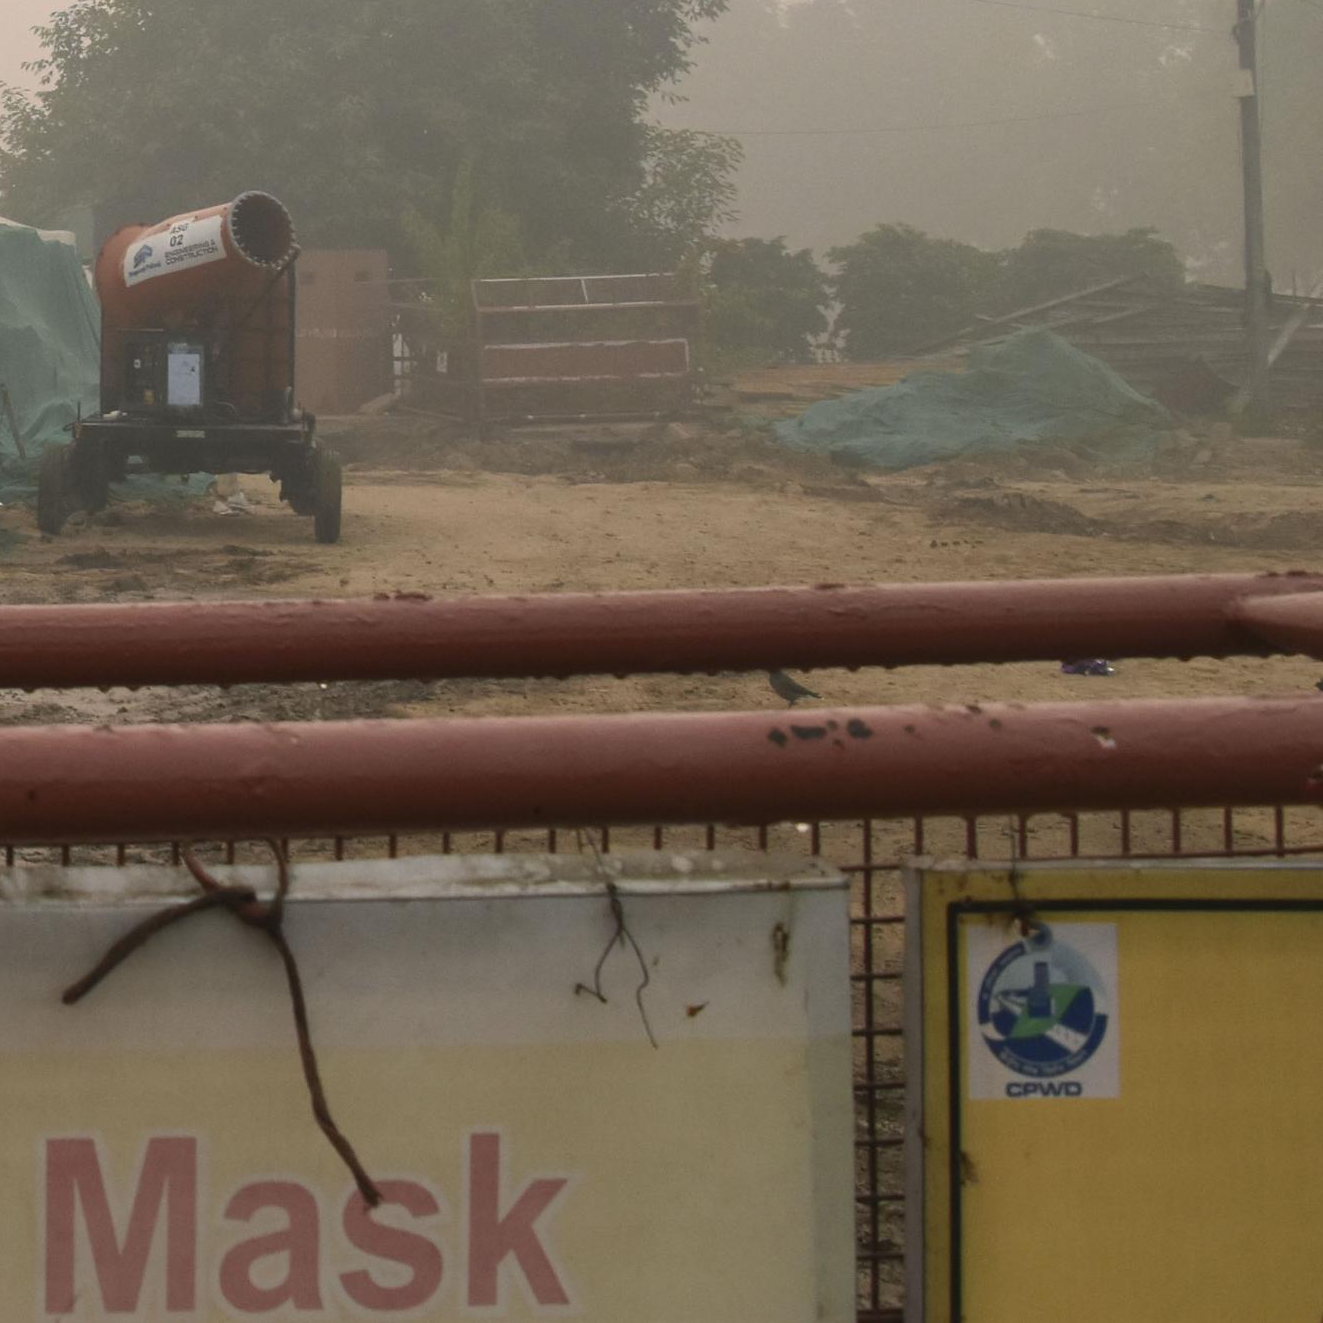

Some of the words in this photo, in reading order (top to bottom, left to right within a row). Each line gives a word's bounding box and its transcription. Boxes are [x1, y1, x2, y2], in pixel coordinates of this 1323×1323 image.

[170, 235, 183, 247] 02
[165, 247, 218, 265] CONSTRUCTION
[1006, 1082, 1081, 1097] CPWD
[42, 1132, 570, 1315] Mask
